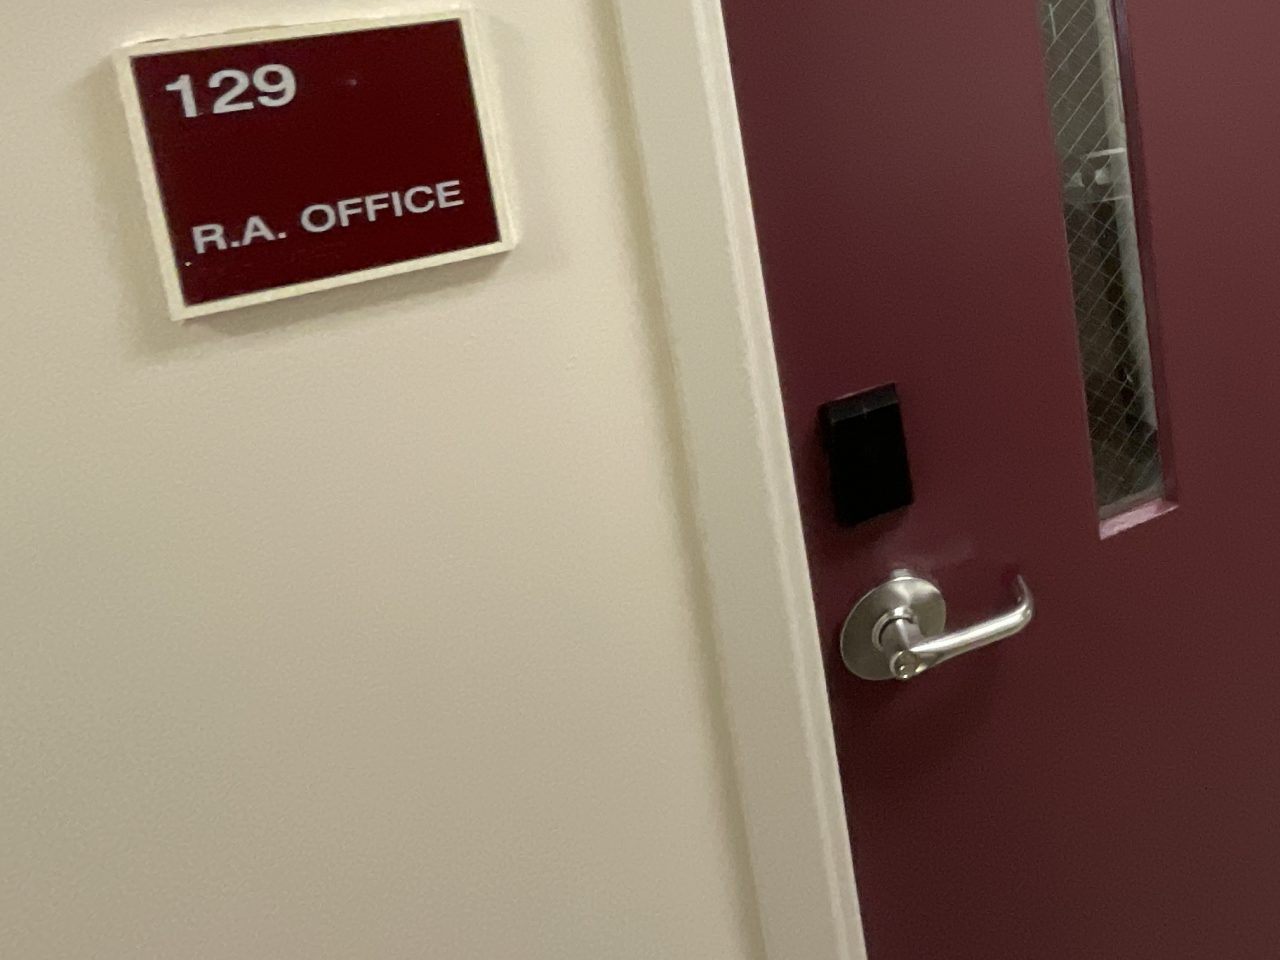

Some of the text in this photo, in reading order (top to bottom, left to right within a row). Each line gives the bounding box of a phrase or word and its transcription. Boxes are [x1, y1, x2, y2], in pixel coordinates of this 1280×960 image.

[166, 64, 297, 118] 129
[191, 179, 465, 254] R.A. OFFICE
